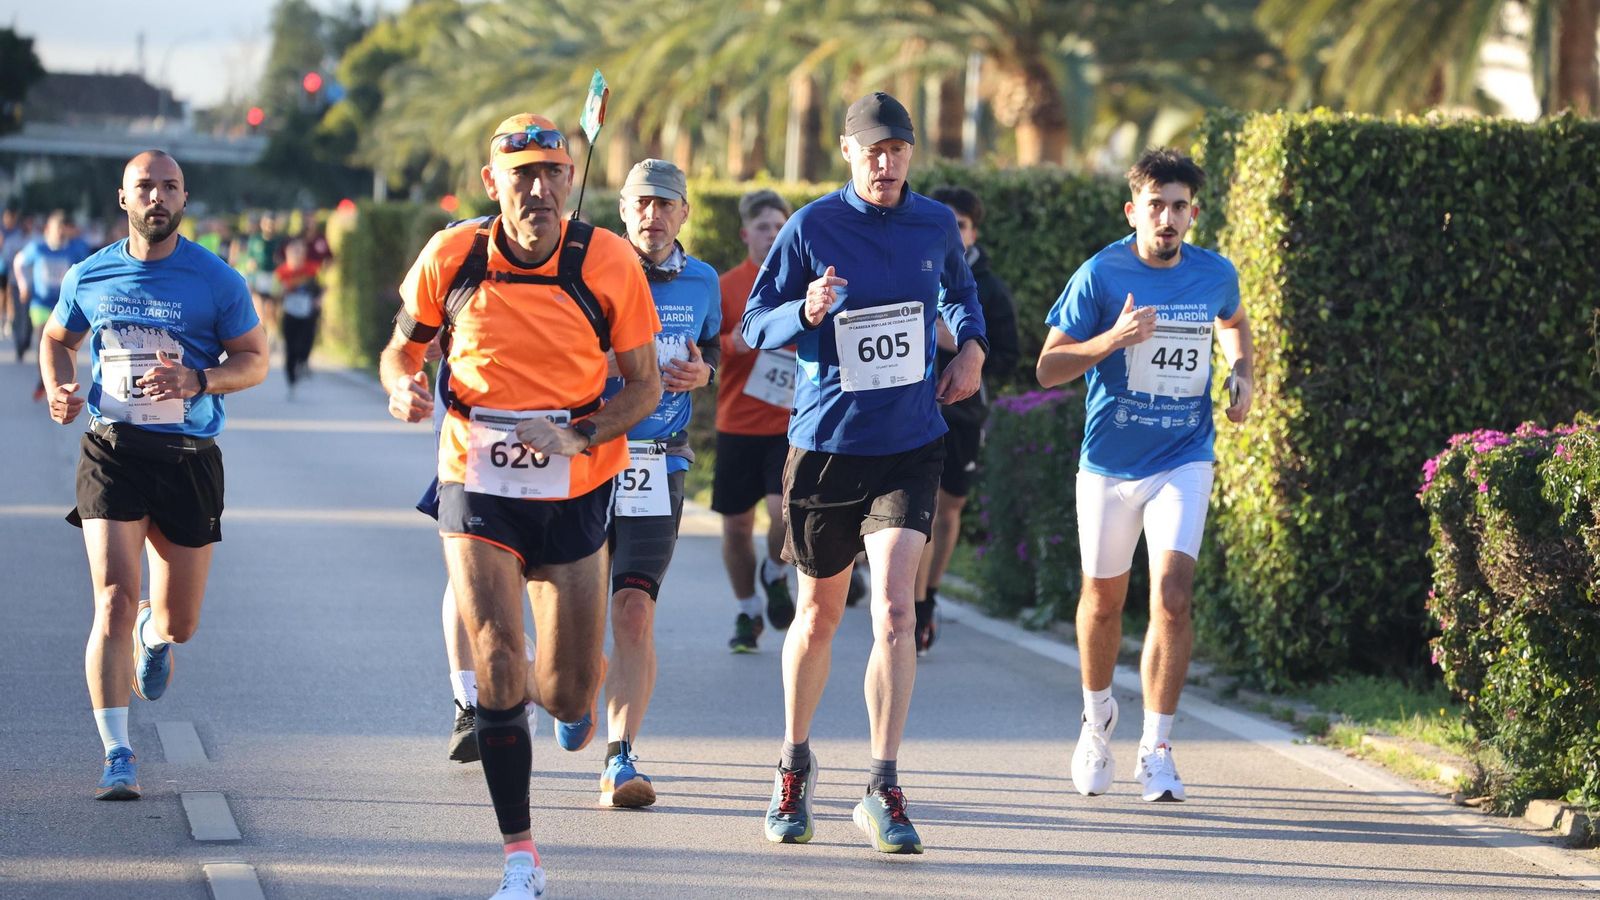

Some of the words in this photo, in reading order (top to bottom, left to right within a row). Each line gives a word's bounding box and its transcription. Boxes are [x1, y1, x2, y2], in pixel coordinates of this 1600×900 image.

[109, 296, 141, 305] CARRERA
[98, 304, 140, 315] CIUDAD
[858, 332, 910, 362] 605
[1151, 347, 1199, 371] 443
[1117, 397, 1147, 410] Domingo
